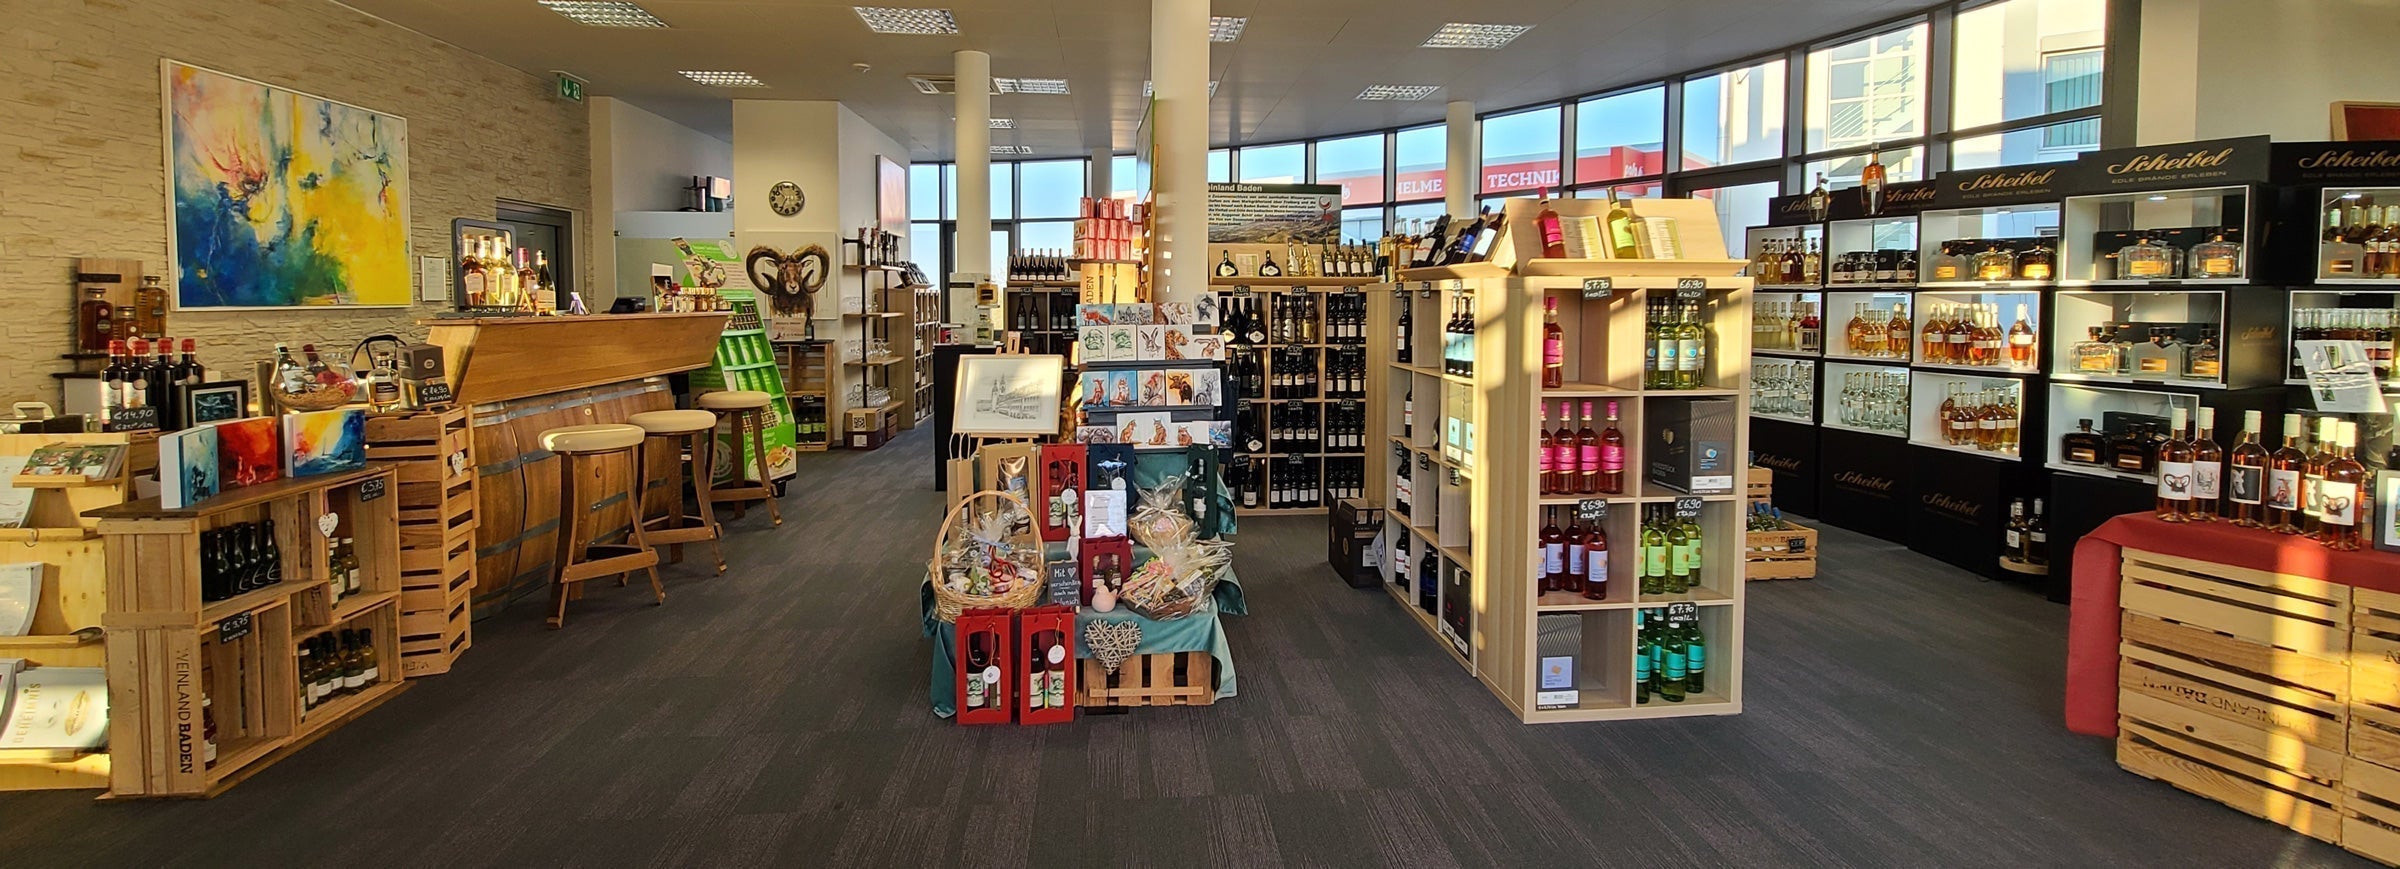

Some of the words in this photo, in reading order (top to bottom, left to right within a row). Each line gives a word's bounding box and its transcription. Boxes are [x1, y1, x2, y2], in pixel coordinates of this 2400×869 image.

[2106, 147, 2234, 174] Scheibel
[1487, 169, 1560, 189] TECHNIK
[1958, 167, 2056, 191] Scheibel
[2181, 170, 2227, 180] ERLEBEN
[1208, 184, 1236, 192] inland
[1237, 184, 1263, 192] Baden
[1086, 275, 1094, 305] ADEN
[1833, 471, 1896, 492] Scheibel
[1922, 491, 1985, 517] Scheibel
[1054, 568, 1066, 578] Mit
[176, 648, 191, 721] WEINLAND
[178, 723, 193, 774] BADEN
